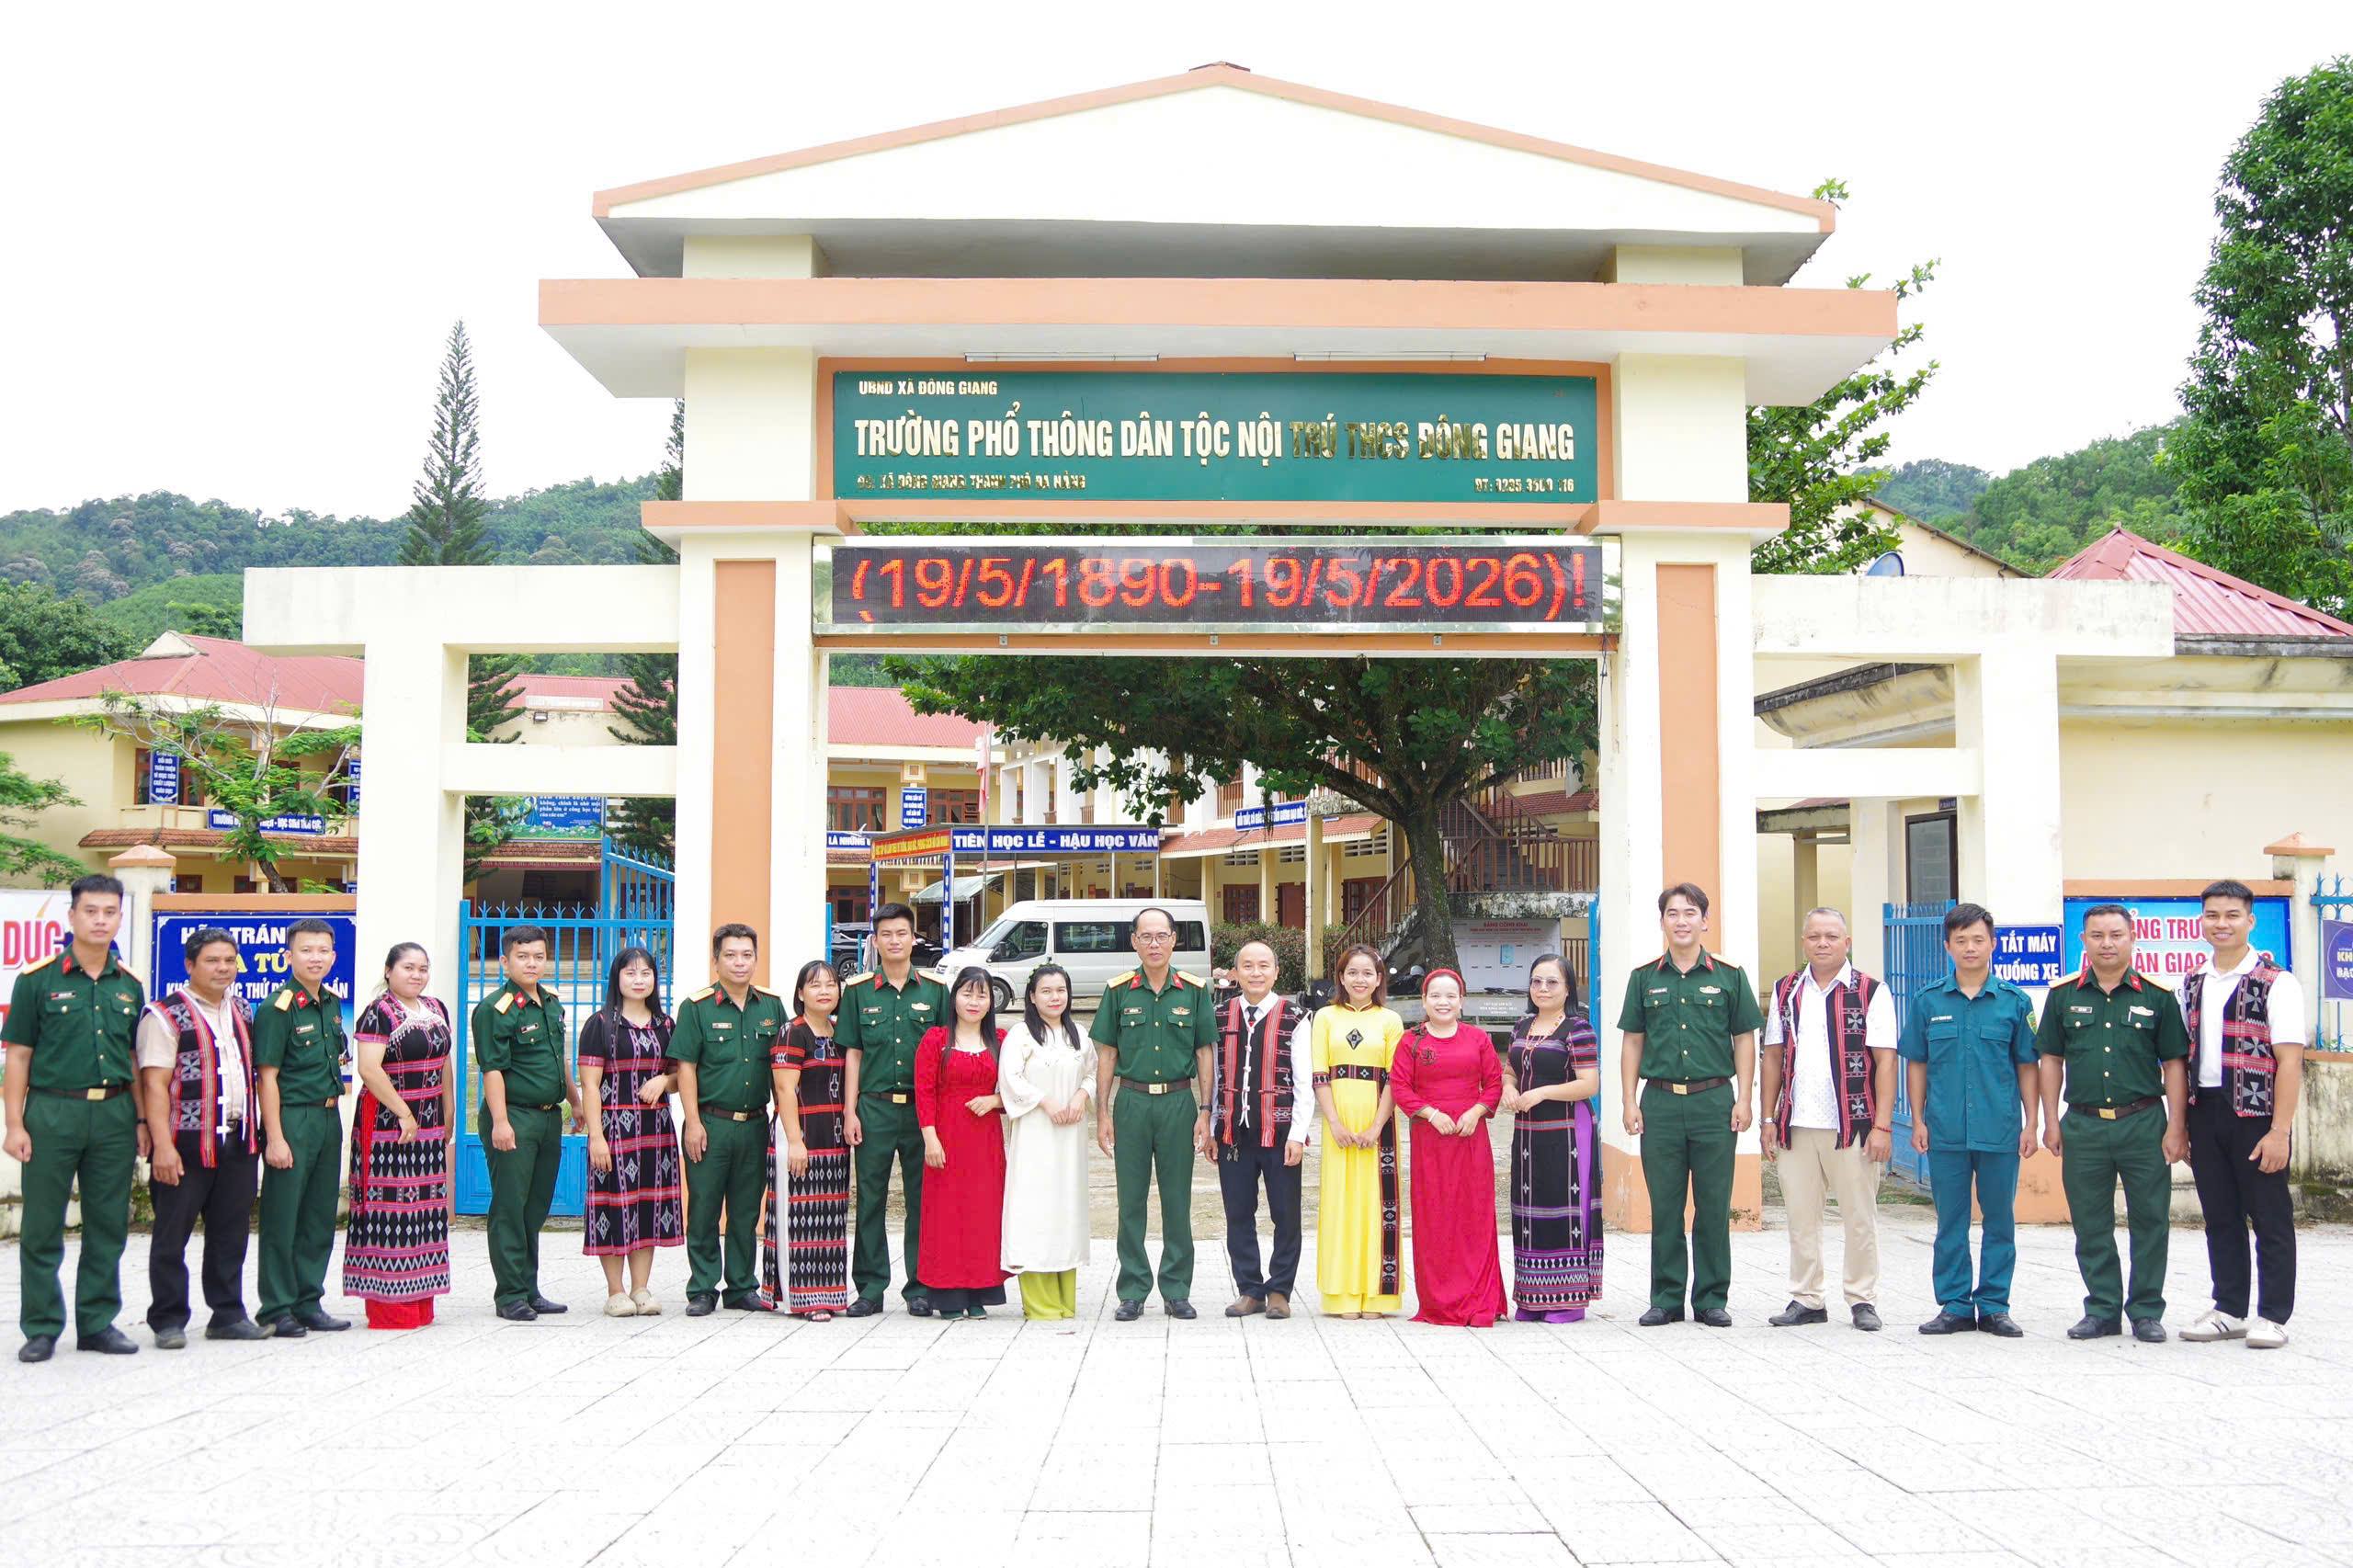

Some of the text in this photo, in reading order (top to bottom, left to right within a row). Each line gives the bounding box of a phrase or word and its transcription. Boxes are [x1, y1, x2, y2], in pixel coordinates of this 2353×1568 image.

[858, 378, 998, 395] UBND XÃ ĐÔNG GIANG
[855, 401, 1574, 467] TRƯỜNG PHỔ THÔNG DÂN TỘC NỘI TRÚ THCS ĐÔNG GIANG
[953, 833, 985, 847] TIÊN
[993, 835, 1023, 849] HỌC
[1028, 831, 1045, 847] LỄ
[1060, 833, 1090, 849] HẬU
[1095, 835, 1124, 849] HỌC
[1129, 833, 1158, 847] VĂN
[229, 921, 289, 945] TRÁN
[2000, 930, 2056, 953] TẮT MÁY
[1994, 958, 2059, 981] XUỐNG XE
[245, 977, 270, 999] THỬ
